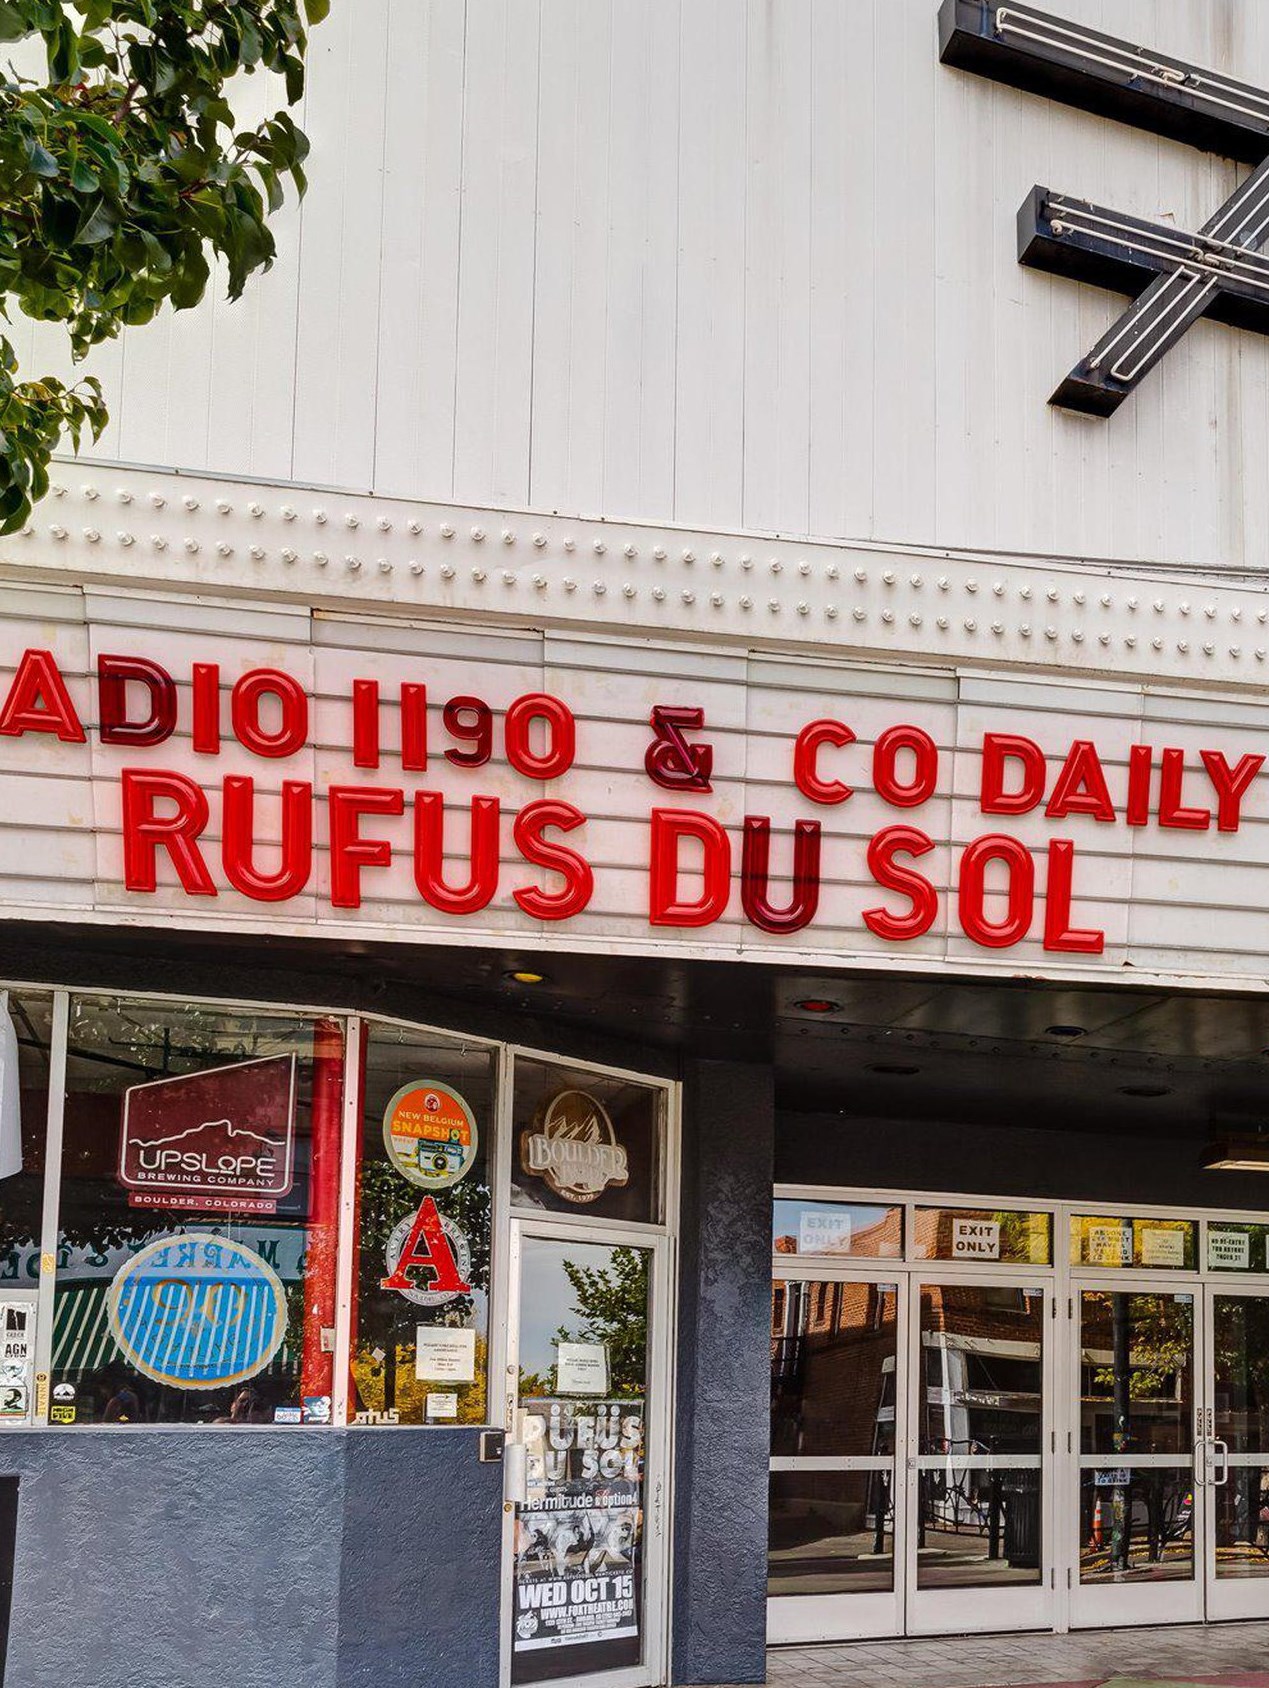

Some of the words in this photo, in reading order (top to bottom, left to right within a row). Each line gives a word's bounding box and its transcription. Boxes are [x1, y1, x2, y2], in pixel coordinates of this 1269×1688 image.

[645, 705, 713, 794] &
[981, 732, 1266, 832] DAILY
[121, 767, 594, 921] RUFUS
[649, 807, 822, 935] DU
[862, 825, 1104, 953] SOL
[398, 1110, 421, 1120] NEW
[423, 1114, 464, 1127] BELGIUM
[391, 1120, 470, 1145] SNAPSHOT
[139, 1150, 277, 1177] UPSLOPE
[137, 1171, 201, 1182] BREWING
[207, 1175, 275, 1187] COMPANY
[134, 1195, 200, 1207] BOULDER,
[205, 1200, 273, 1210] COLORADO
[807, 1217, 844, 1230] EXIT
[958, 1225, 994, 1237] EXIT
[803, 1234, 848, 1250] ONLY
[956, 1240, 996, 1254] ONLY
[5, 1343, 27, 1355] AGN
[520, 1492, 593, 1511] Hermitude
[519, 1581, 567, 1610] WED
[571, 1577, 610, 1604] OCT
[612, 1575, 633, 1599] 15
